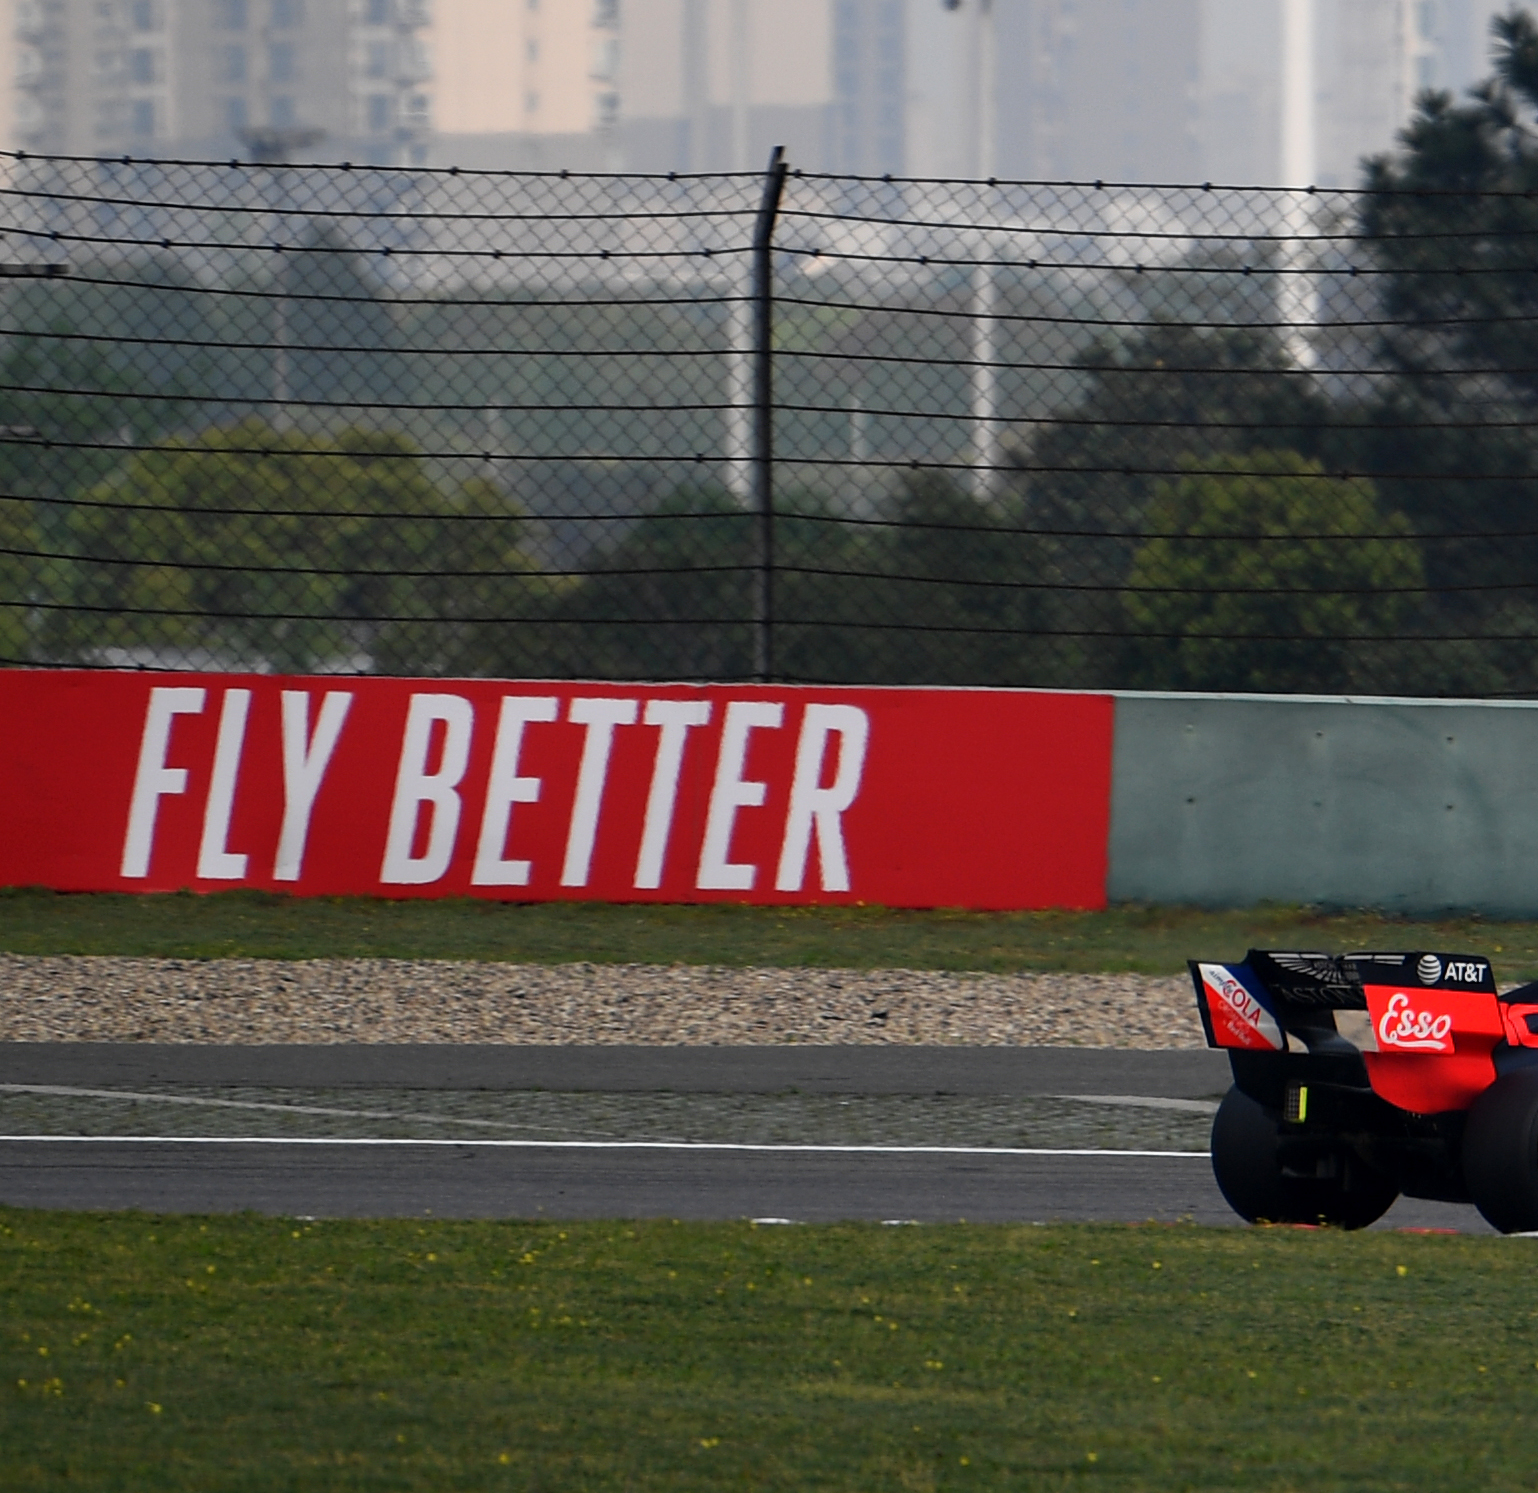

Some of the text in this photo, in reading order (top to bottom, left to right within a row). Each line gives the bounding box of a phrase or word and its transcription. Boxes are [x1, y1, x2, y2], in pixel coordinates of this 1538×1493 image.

[120, 686, 870, 892] FLY BETTER
[1444, 962, 1488, 983] AT&T
[1222, 979, 1261, 1026] COLA
[1379, 993, 1453, 1050] Esso
